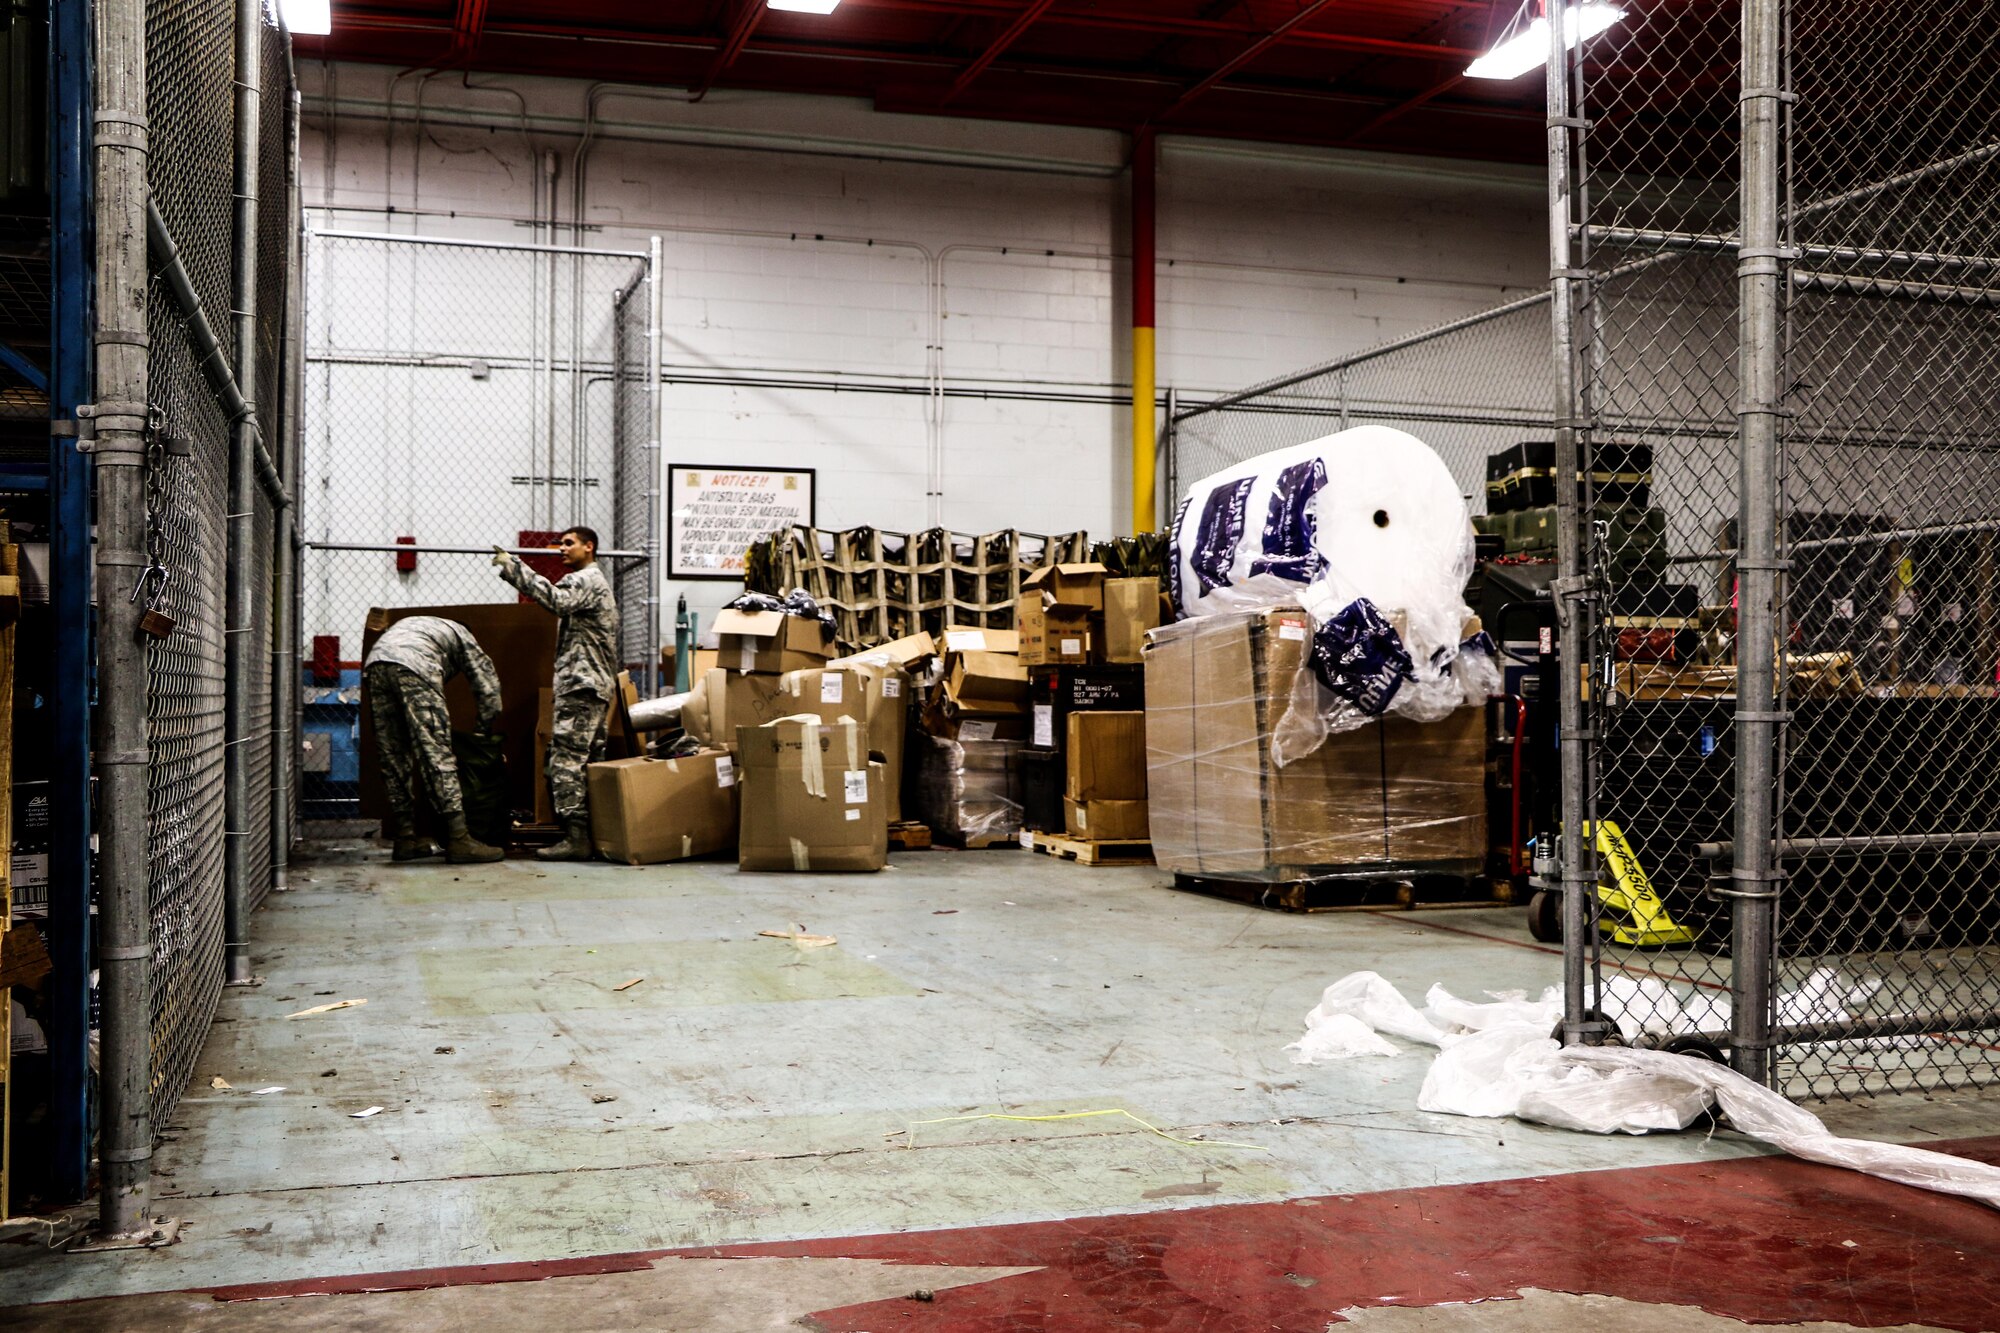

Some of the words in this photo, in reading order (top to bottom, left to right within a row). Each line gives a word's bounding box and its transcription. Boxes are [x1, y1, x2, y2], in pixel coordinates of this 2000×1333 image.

[711, 475, 769, 487] NOTICE!!
[698, 491, 748, 503] ANTISTATIC
[748, 492, 776, 504] BAGS
[1231, 478, 1252, 532] ULINE
[759, 506, 800, 518] MATERIAL
[681, 517, 700, 528] MAY
[701, 518, 713, 529] BE
[714, 518, 745, 529] OPENED
[746, 519, 767, 530] ONLY
[768, 519, 780, 530] IN
[1169, 501, 1190, 551] ULINE
[681, 529, 727, 542] APPROVED
[726, 530, 754, 543] WORK
[680, 542, 694, 554] WE
[693, 543, 716, 555] HAVE
[716, 544, 731, 556] NO
[720, 556, 736, 569] DO
